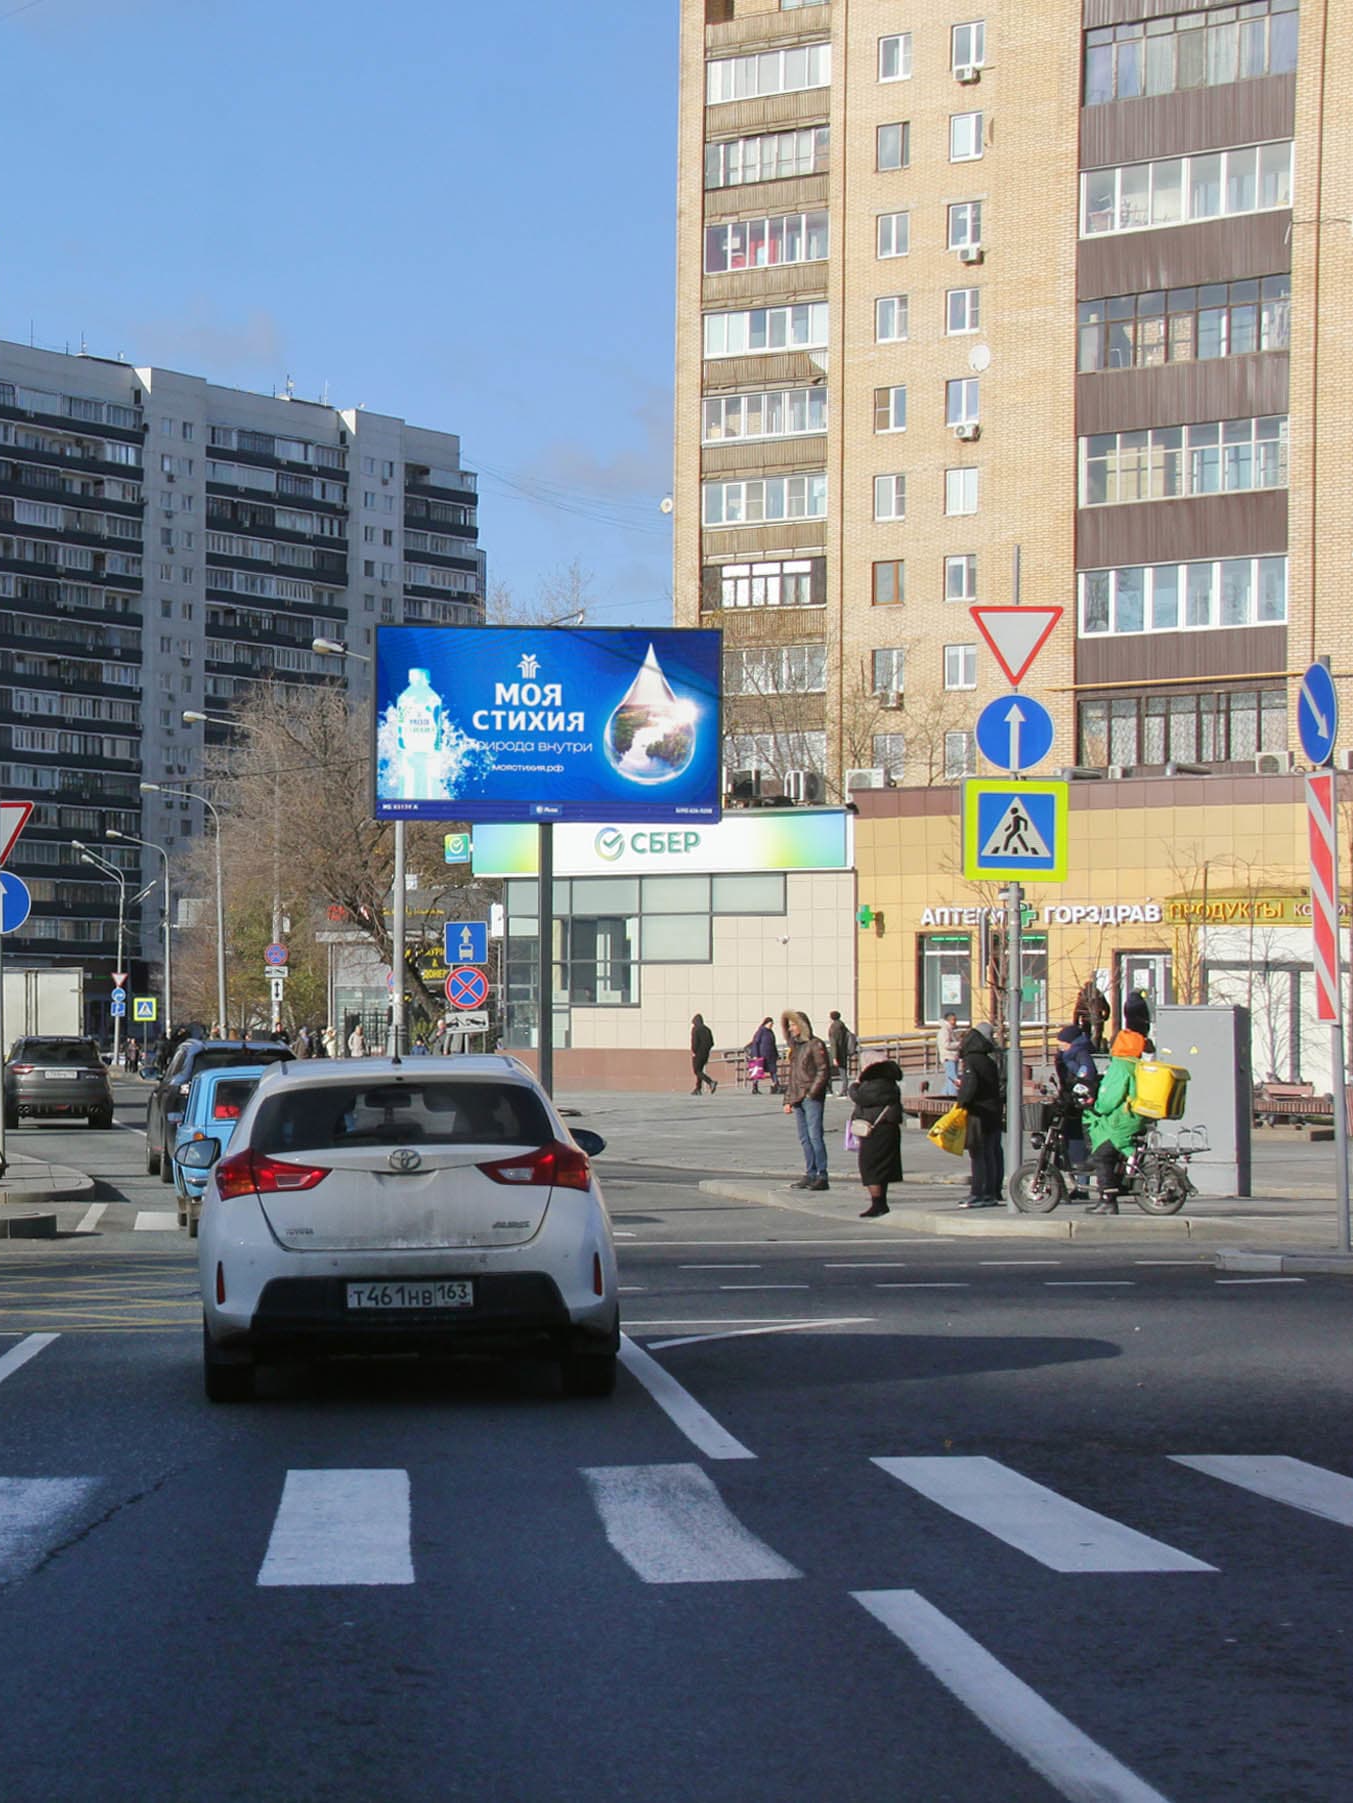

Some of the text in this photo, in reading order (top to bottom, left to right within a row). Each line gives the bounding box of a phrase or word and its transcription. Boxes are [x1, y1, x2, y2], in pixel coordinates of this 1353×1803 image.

[494, 682, 562, 706] МОЯ
[472, 710, 585, 732] СТИХИЯ
[538, 741, 593, 754] внутри
[630, 831, 701, 854] СБЕР
[1044, 904, 1162, 927] ГОРЗДРАВ
[1169, 902, 1284, 922] ПРОДУКТЫ
[437, 1283, 468, 1300] 163
